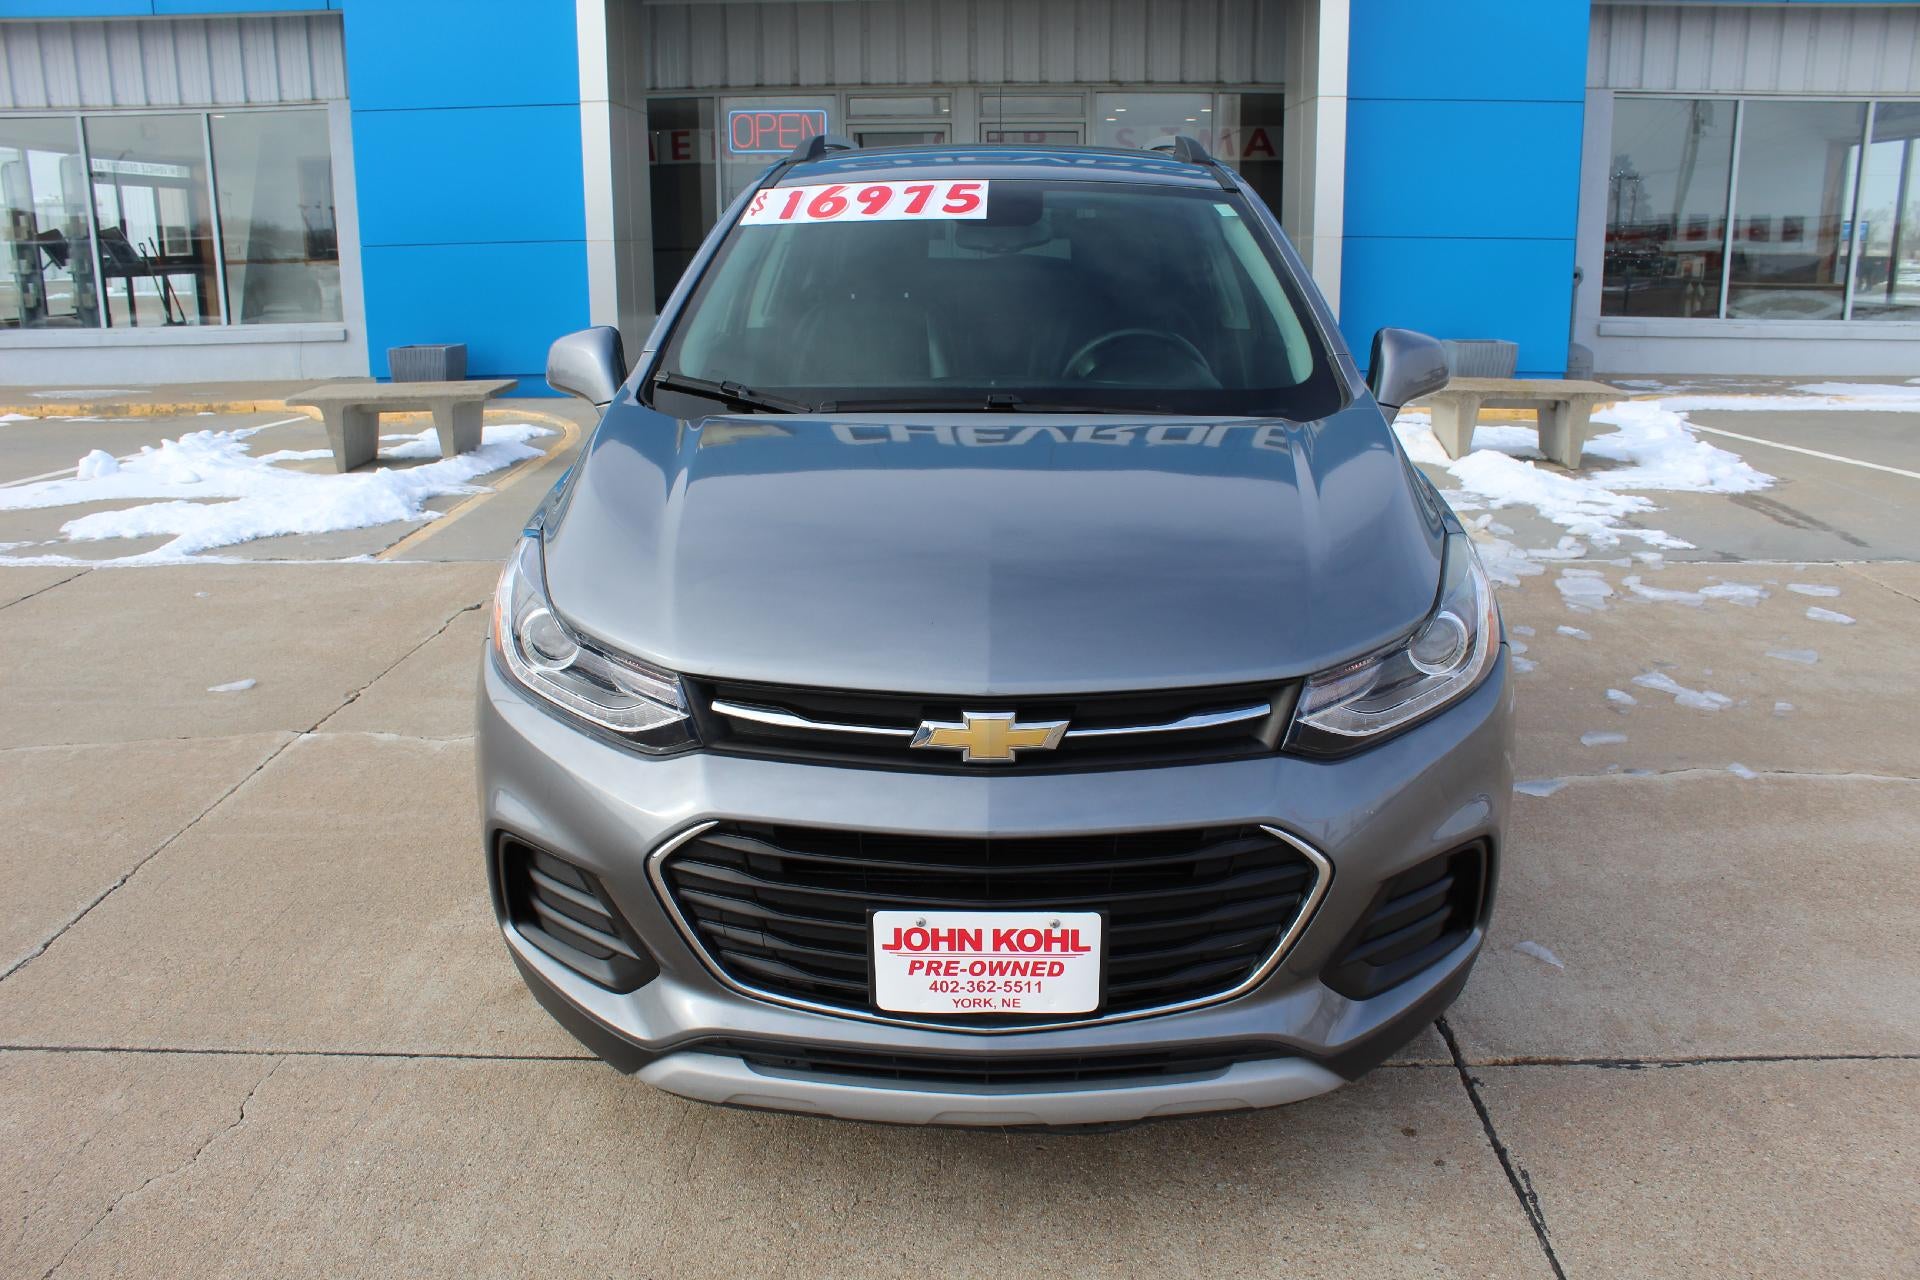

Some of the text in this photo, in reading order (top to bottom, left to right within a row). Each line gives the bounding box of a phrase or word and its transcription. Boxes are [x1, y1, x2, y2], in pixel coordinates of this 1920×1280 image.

[733, 113, 824, 149] OPEN
[882, 927, 1092, 952] JOHN KOHL
[908, 959, 1065, 977] PRE-OWNED
[928, 980, 1043, 993] 402-362-5511
[952, 998, 1022, 1010] YORK, NE
